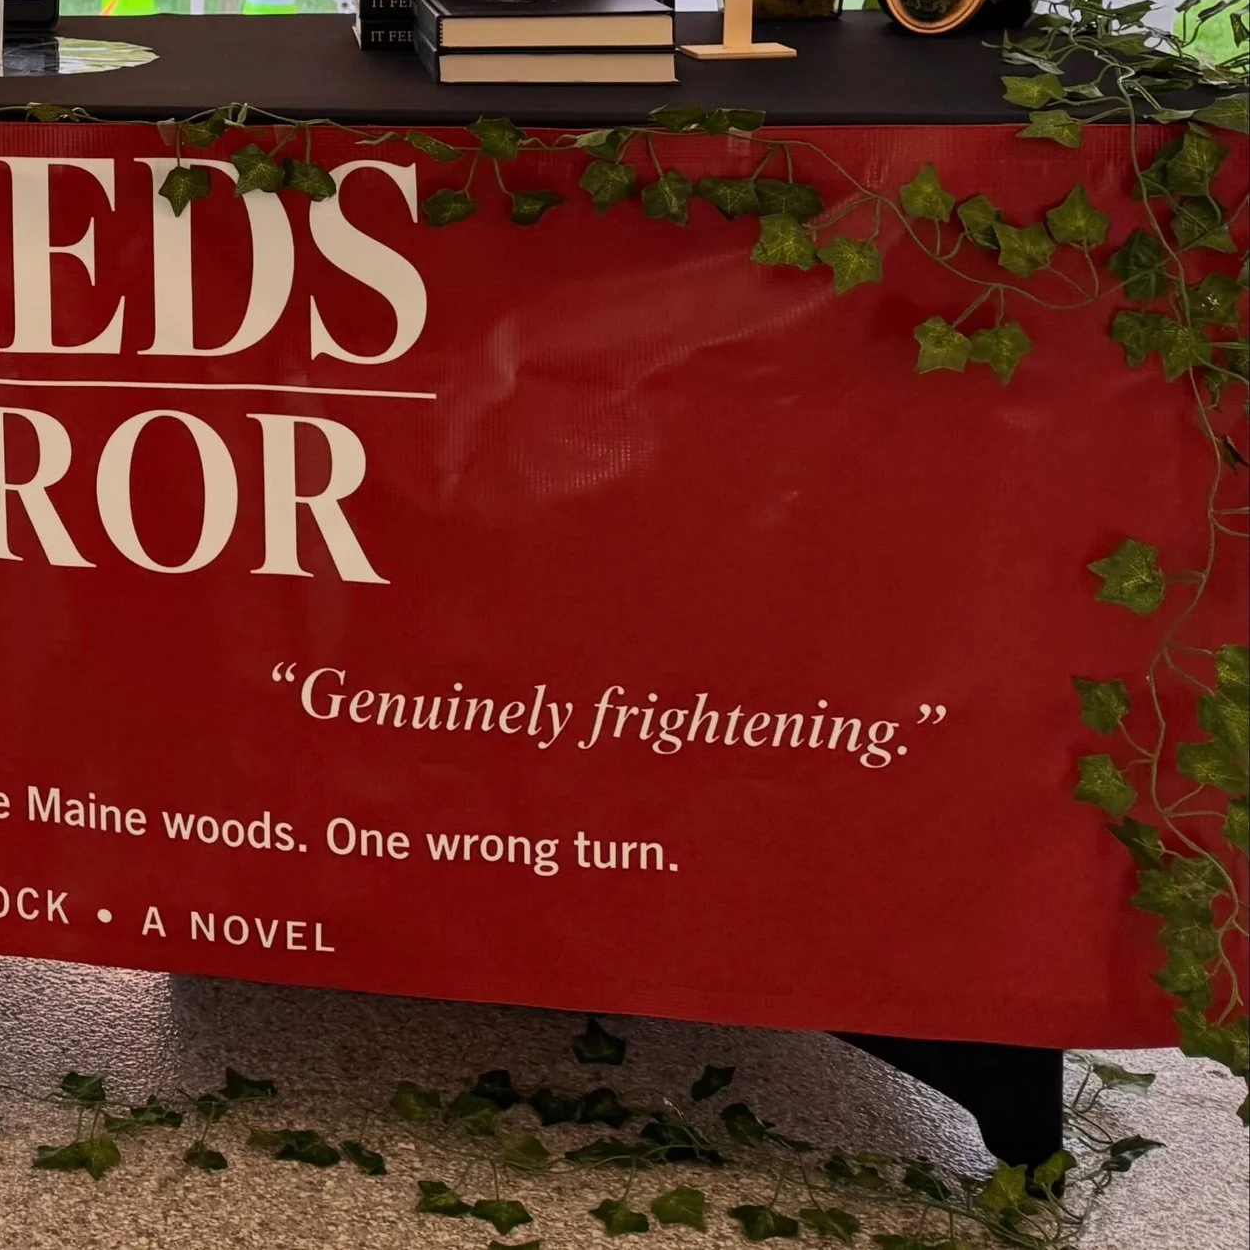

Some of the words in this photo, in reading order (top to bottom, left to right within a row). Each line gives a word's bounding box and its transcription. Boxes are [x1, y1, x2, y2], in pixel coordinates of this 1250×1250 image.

[371, 30, 385, 43] IT
[26, 785, 147, 835] Maine
[161, 811, 308, 853] woods.
[325, 817, 411, 860] One
[426, 833, 559, 876] wrong
[573, 830, 679, 872] turn.
[141, 905, 167, 938] A
[189, 911, 336, 952] NOVEL
